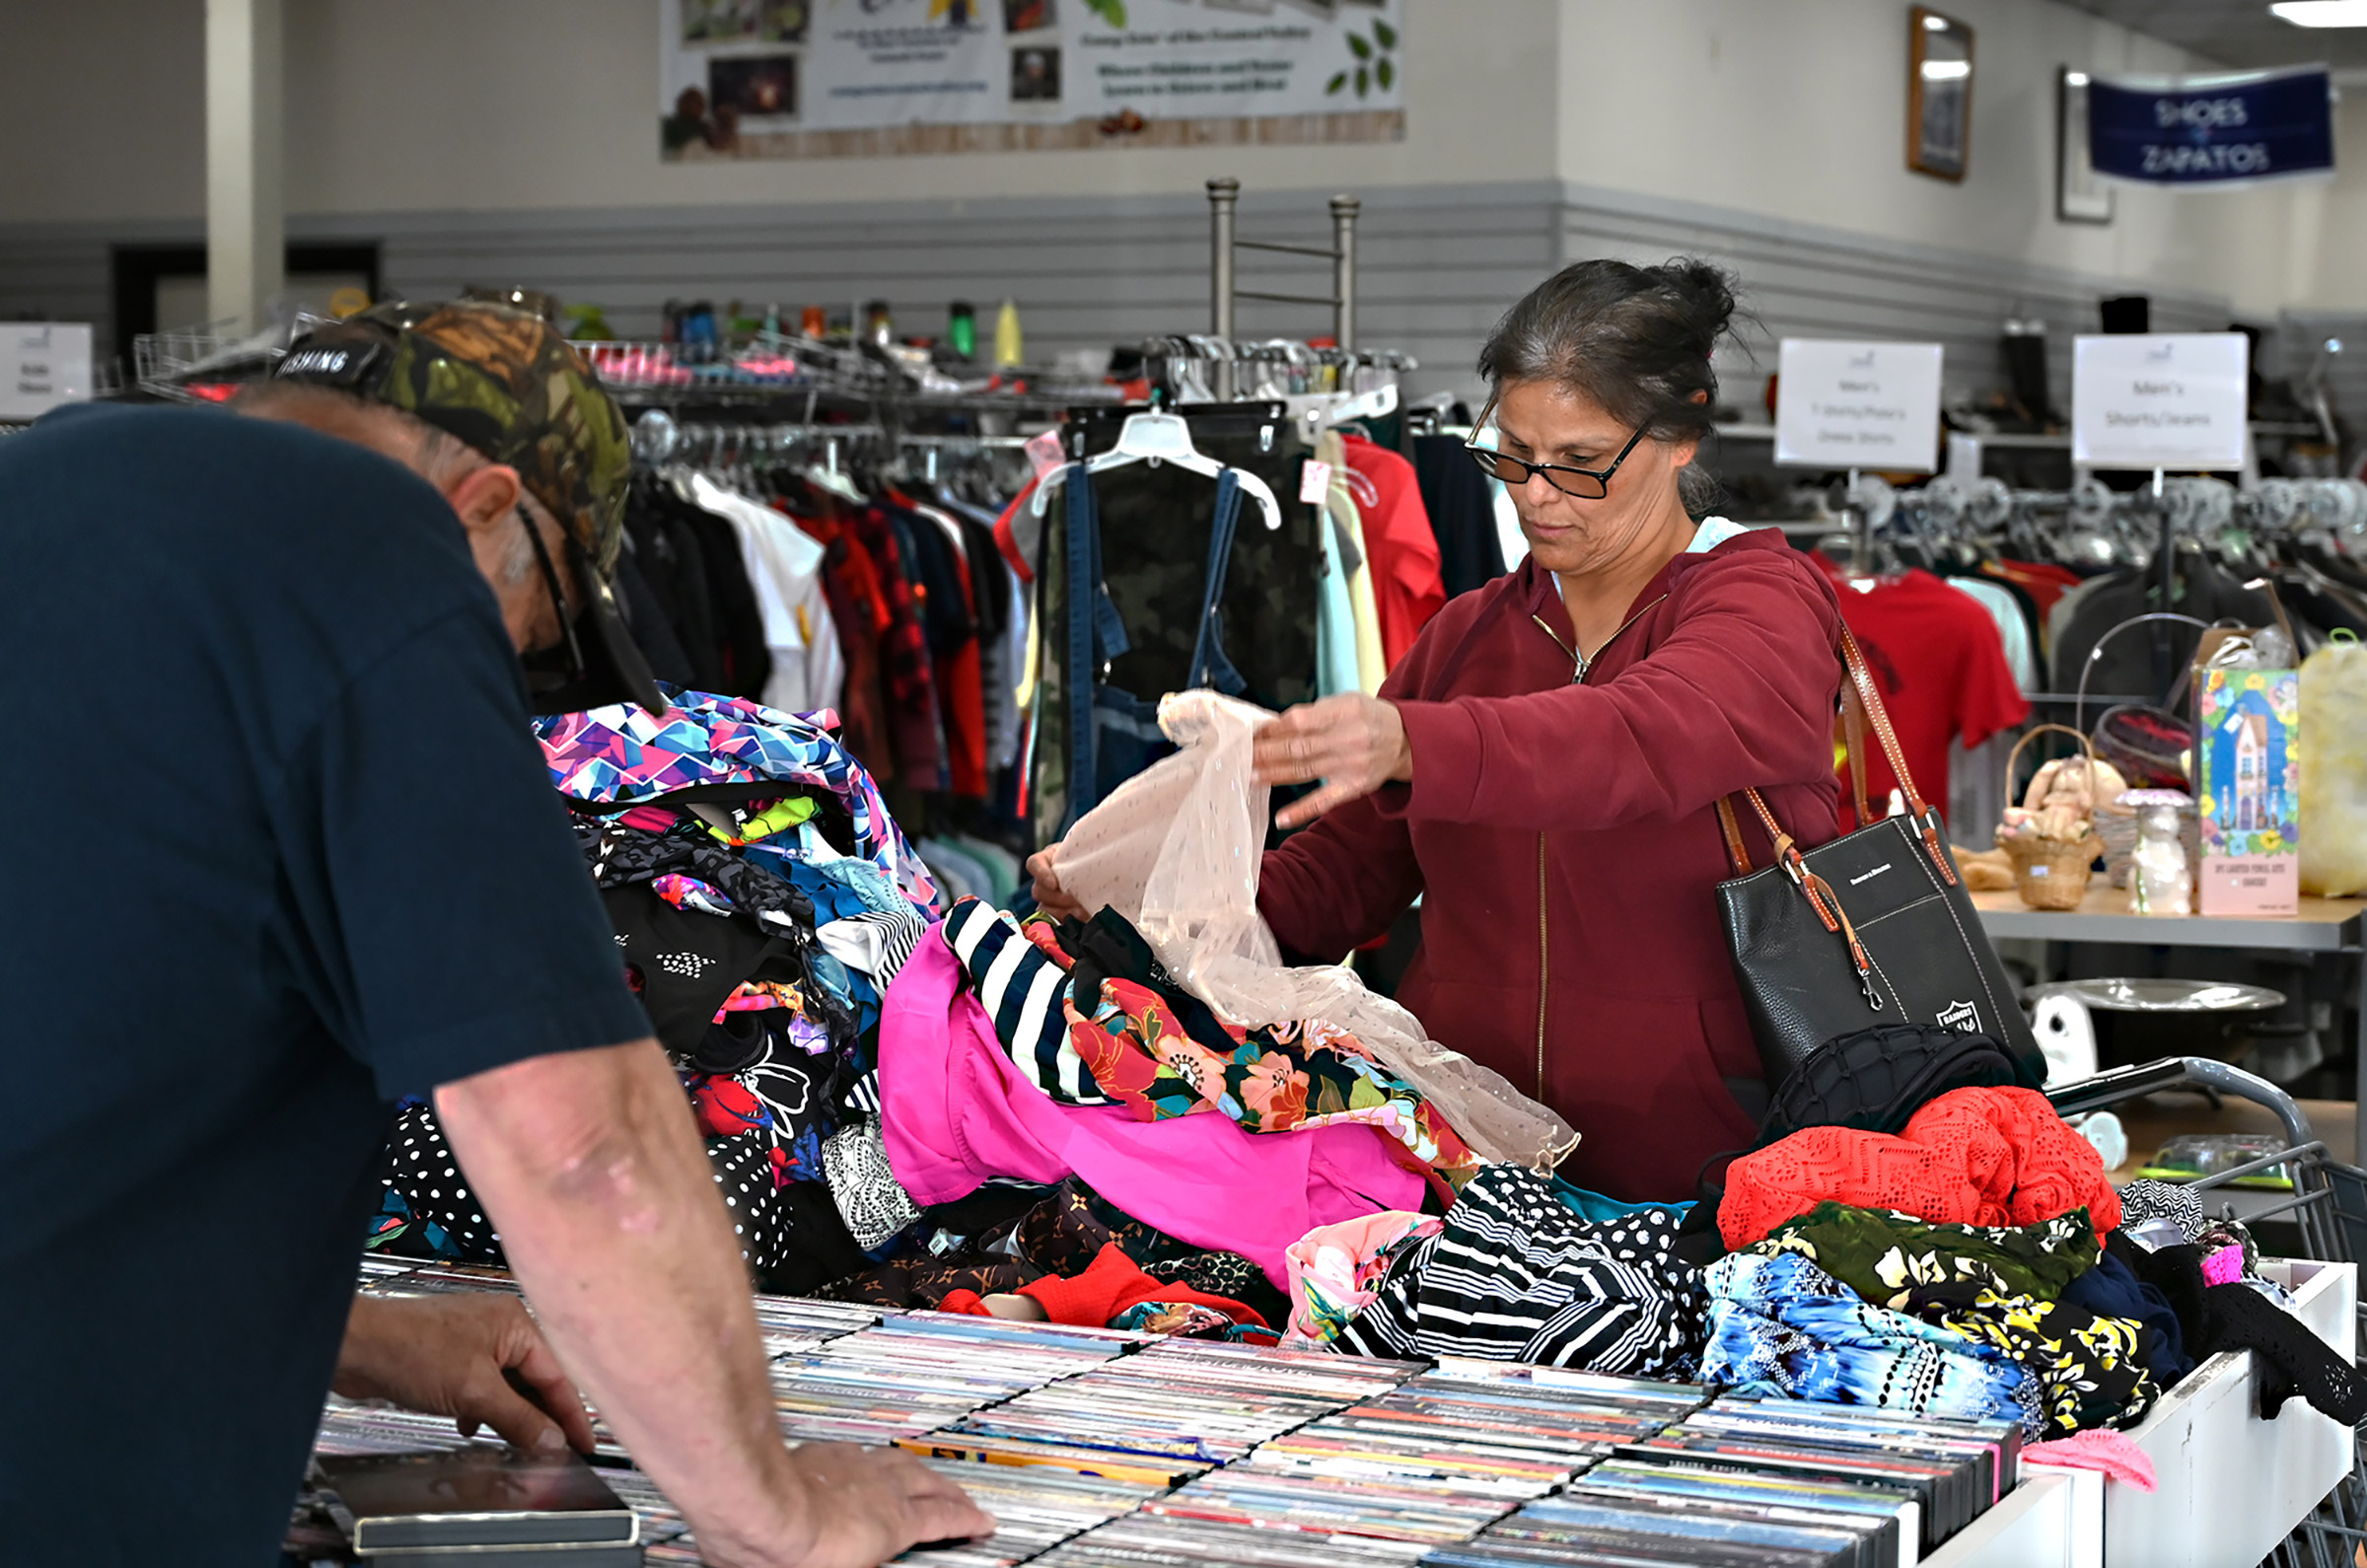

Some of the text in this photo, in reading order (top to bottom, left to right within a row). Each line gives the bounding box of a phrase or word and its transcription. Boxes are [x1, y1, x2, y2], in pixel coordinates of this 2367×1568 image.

[2155, 98, 2248, 127] SHOES
[2141, 143, 2270, 174] ZAPATOS
[2132, 379, 2185, 396] Men's
[2104, 409, 2211, 428] Shorts/Jeans
[1943, 1007, 1972, 1025] RAIDERS
